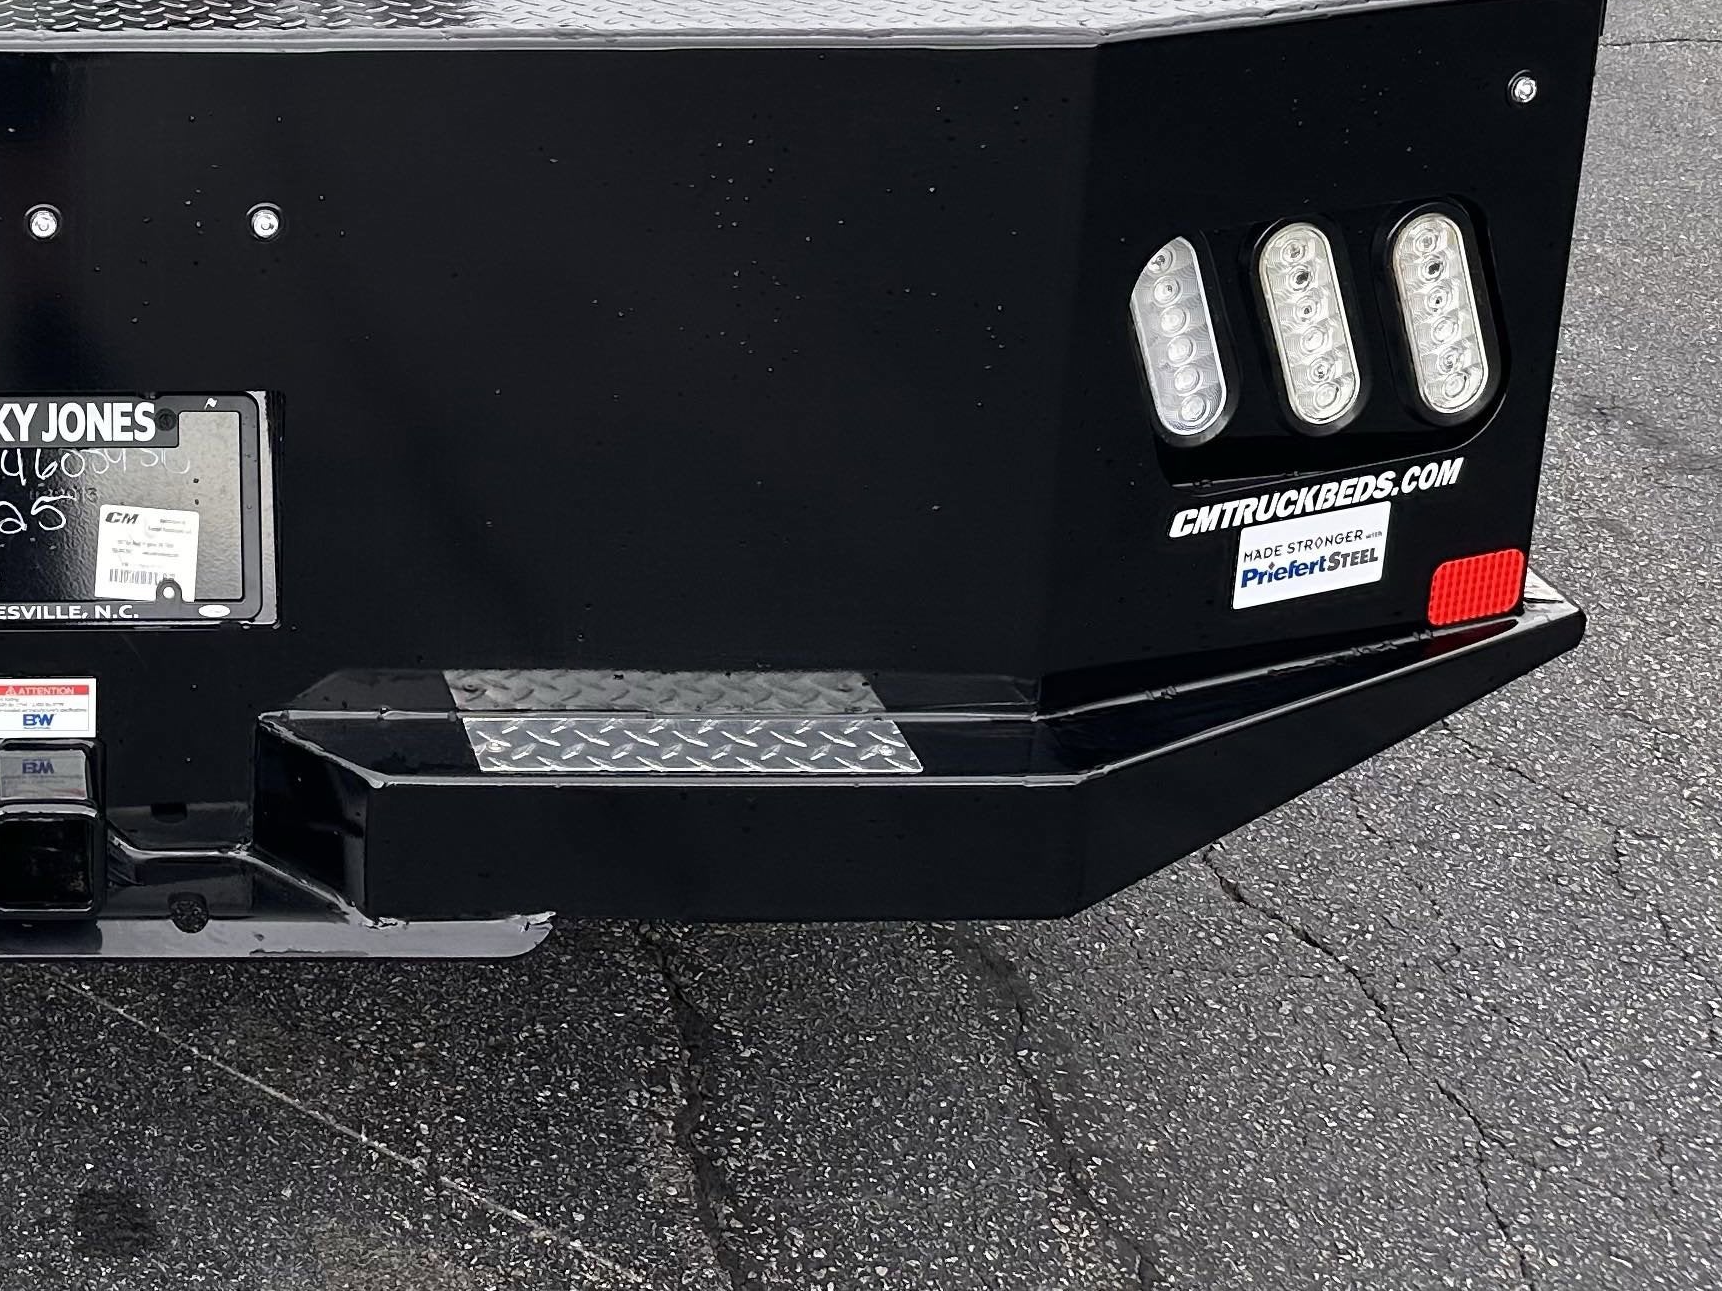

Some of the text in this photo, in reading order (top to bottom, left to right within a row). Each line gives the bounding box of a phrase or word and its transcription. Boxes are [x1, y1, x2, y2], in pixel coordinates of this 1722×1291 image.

[41, 403, 156, 442] JONES
[1169, 458, 1465, 538] CMTRUCKBEDS.COM
[105, 512, 140, 524] CM
[1243, 545, 1283, 562] MADE
[1286, 529, 1363, 554] STRONGER
[94, 605, 140, 619] N.C.
[18, 687, 75, 695] ATTENTION
